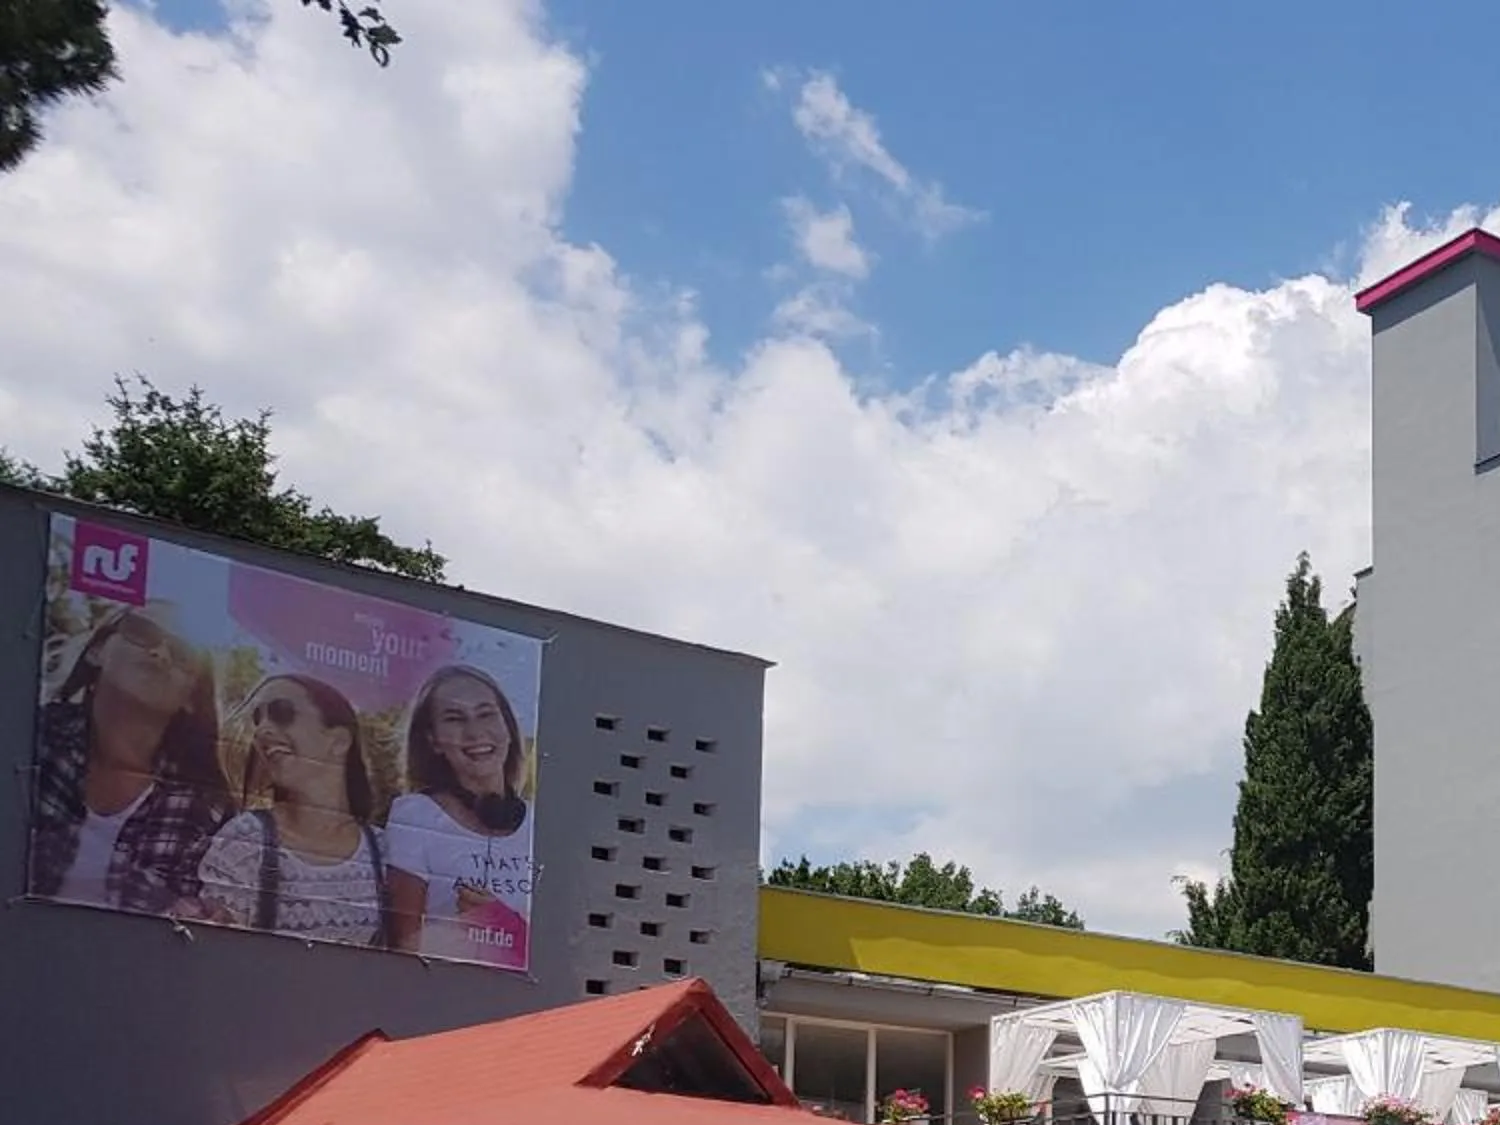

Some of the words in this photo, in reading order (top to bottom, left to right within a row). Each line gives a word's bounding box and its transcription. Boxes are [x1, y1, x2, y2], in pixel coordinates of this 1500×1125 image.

[83, 543, 138, 581] ruf
[306, 641, 389, 677] moment
[371, 627, 429, 659] your
[468, 927, 513, 948] ruf.de
